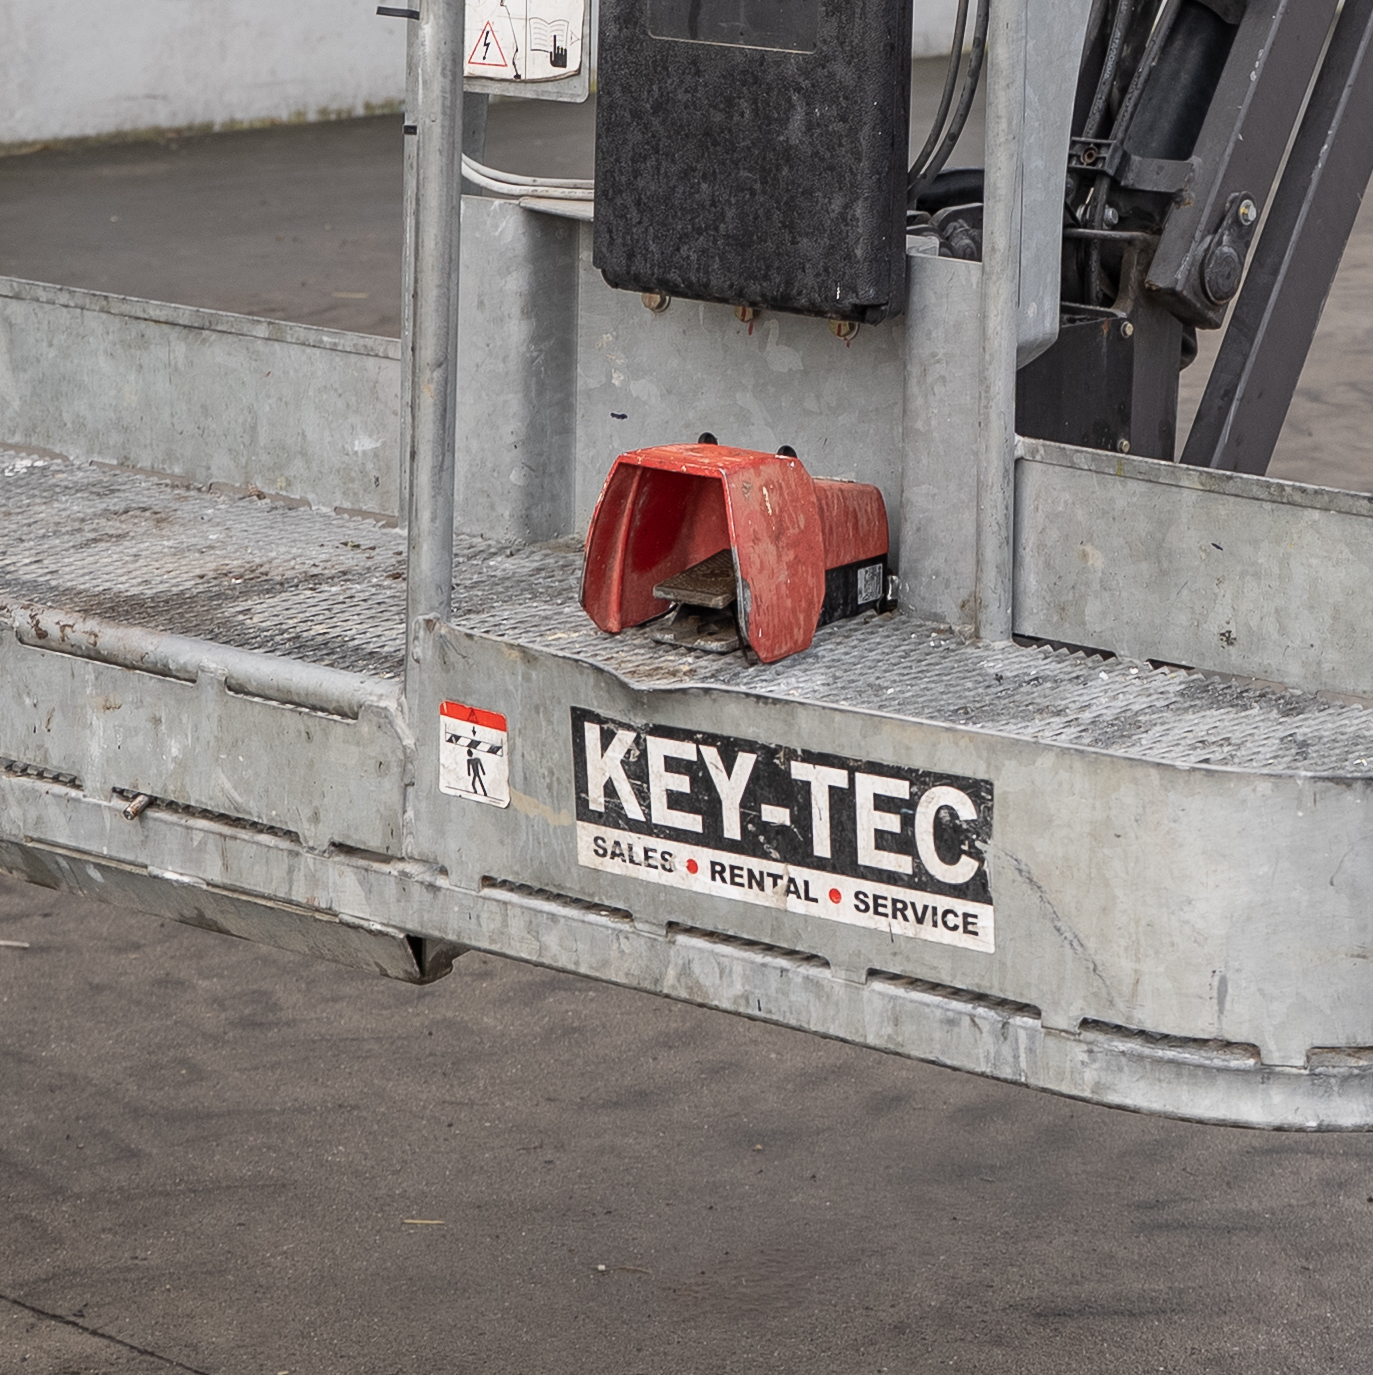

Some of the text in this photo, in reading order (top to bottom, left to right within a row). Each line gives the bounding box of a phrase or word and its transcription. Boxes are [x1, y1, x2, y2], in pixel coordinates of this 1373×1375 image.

[584, 721, 980, 885] KEY-TEC
[593, 835, 979, 937] SALES RENTAL SERVICE
